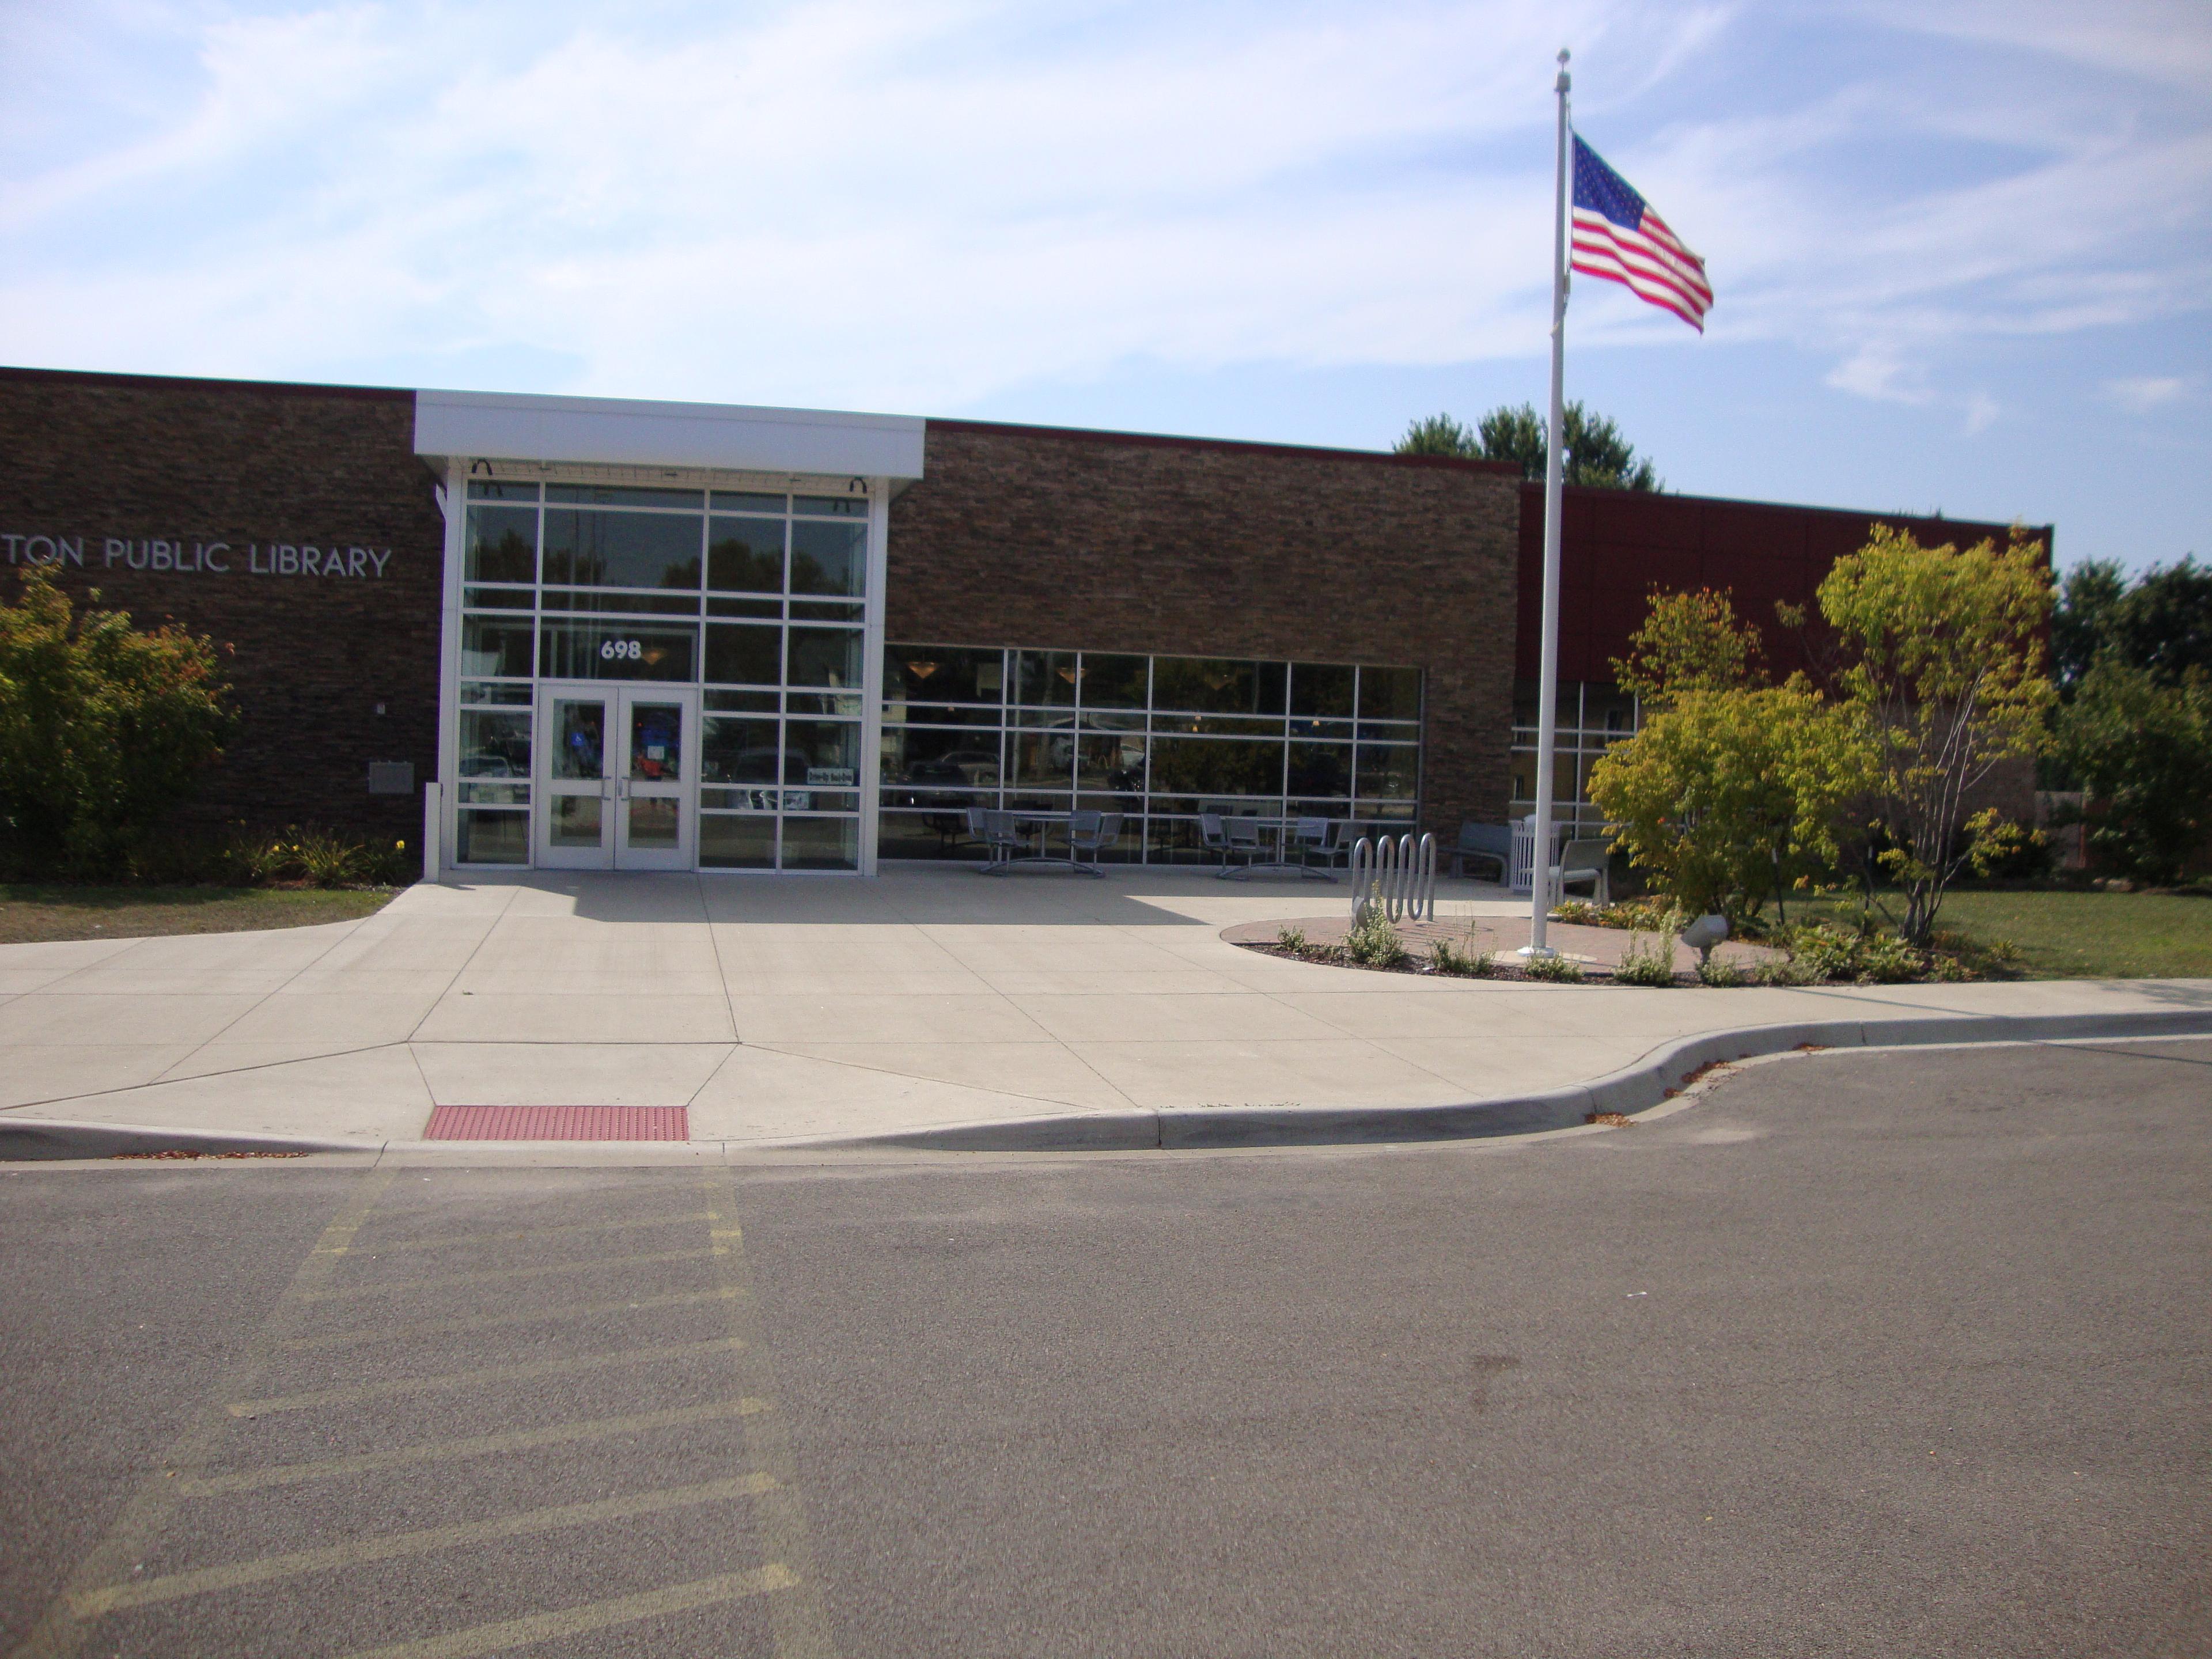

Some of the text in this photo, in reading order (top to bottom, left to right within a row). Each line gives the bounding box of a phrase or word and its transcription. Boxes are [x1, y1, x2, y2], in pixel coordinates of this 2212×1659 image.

[105, 538, 230, 572] PUBLIC
[250, 544, 392, 577] LIBRARY
[601, 640, 642, 660] 698
